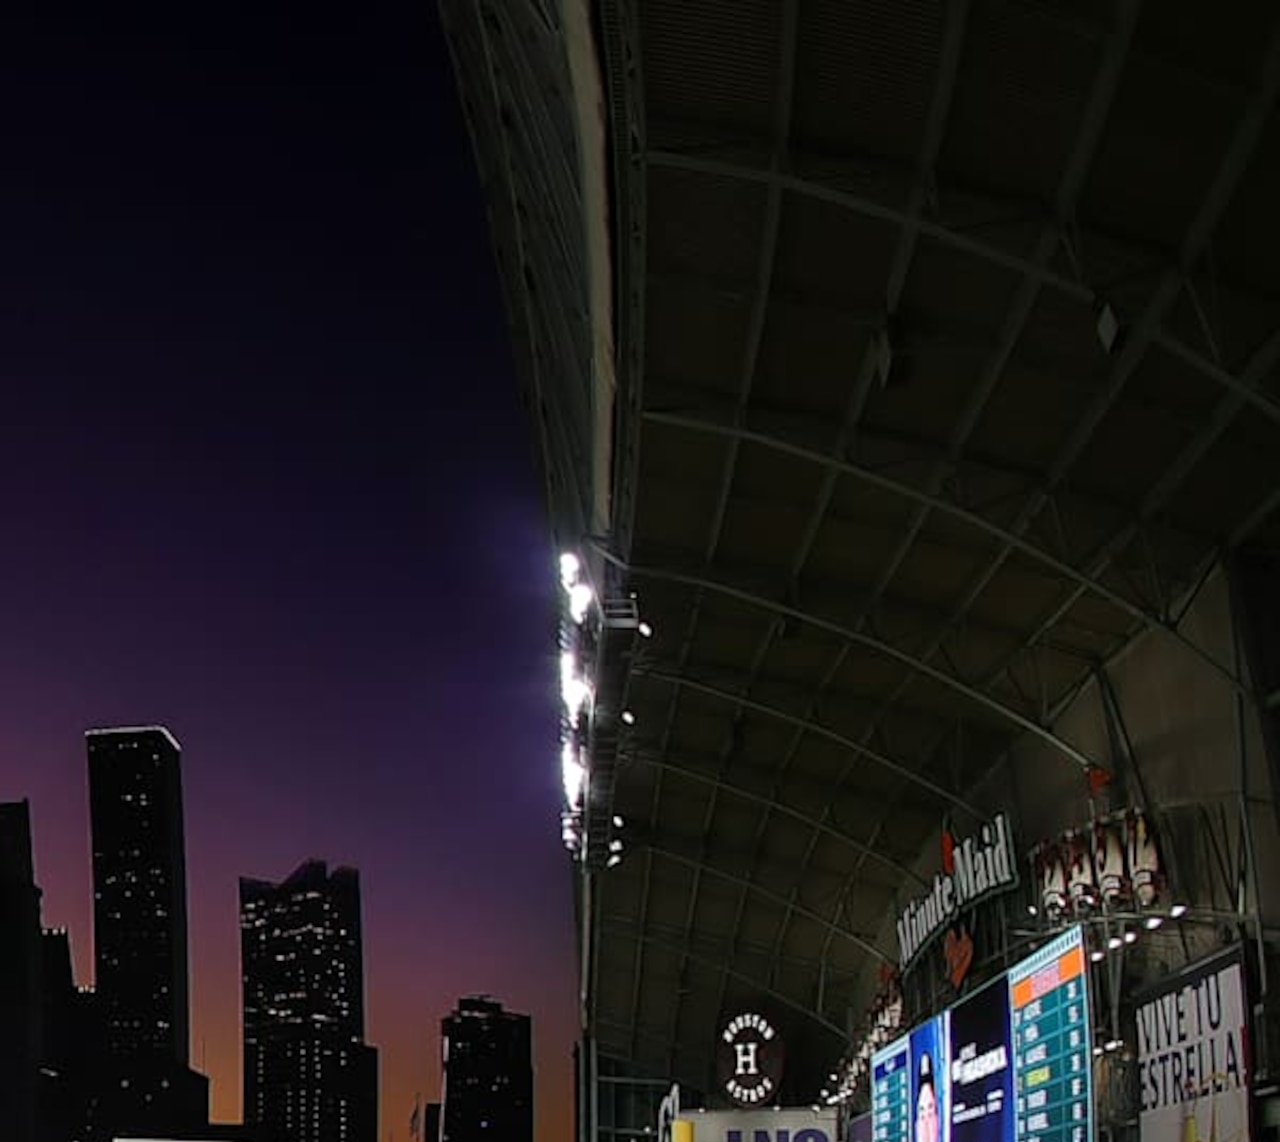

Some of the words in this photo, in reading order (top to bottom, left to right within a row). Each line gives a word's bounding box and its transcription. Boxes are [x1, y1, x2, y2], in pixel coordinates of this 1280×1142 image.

[897, 873, 954, 968] Minute
[953, 814, 1012, 905] Maid
[722, 1014, 775, 1043] HOUSTON
[1192, 973, 1223, 1037] TU
[734, 1043, 759, 1075] H
[1139, 1031, 1241, 1111] ESTRELLA
[726, 1077, 773, 1103] ASTROS
